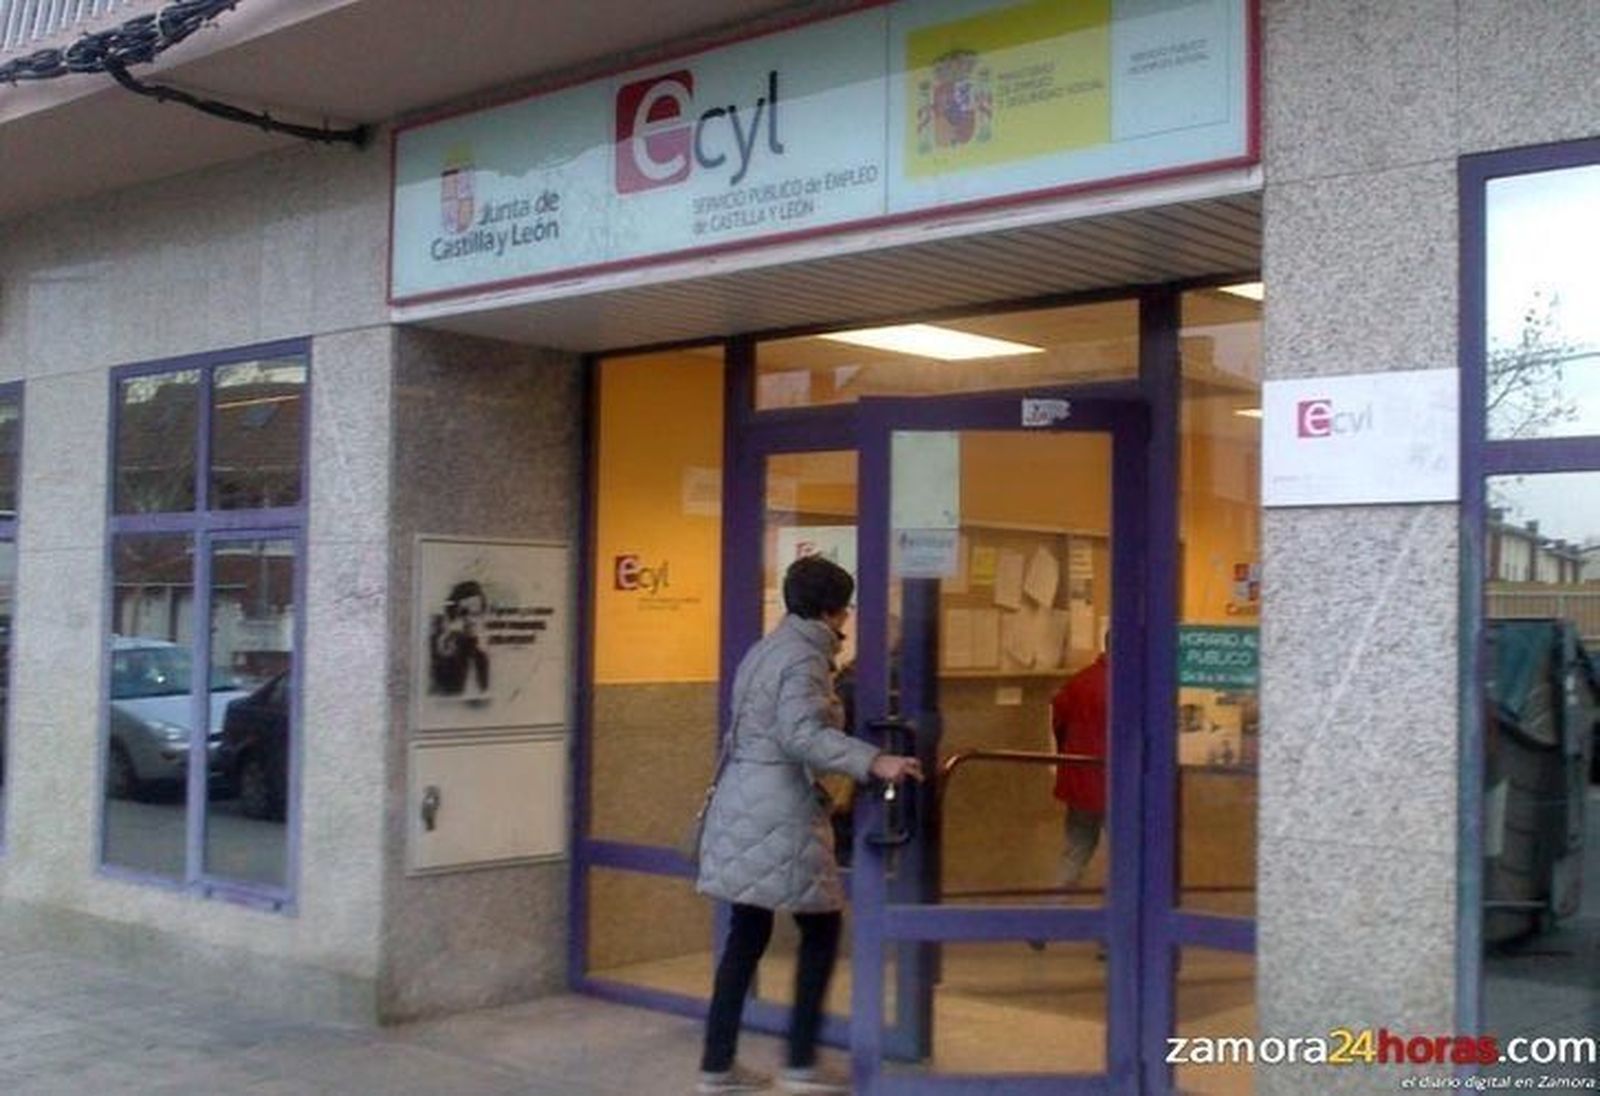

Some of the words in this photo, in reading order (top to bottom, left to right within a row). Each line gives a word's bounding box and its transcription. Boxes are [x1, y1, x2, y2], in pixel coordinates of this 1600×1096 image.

[622, 70, 784, 190] ecyl
[825, 165, 878, 191] EMPLEO
[478, 198, 530, 226] Junta
[534, 190, 560, 215] de
[710, 209, 766, 232] CASTILLA
[431, 228, 495, 261] Castilla
[512, 216, 560, 247] León
